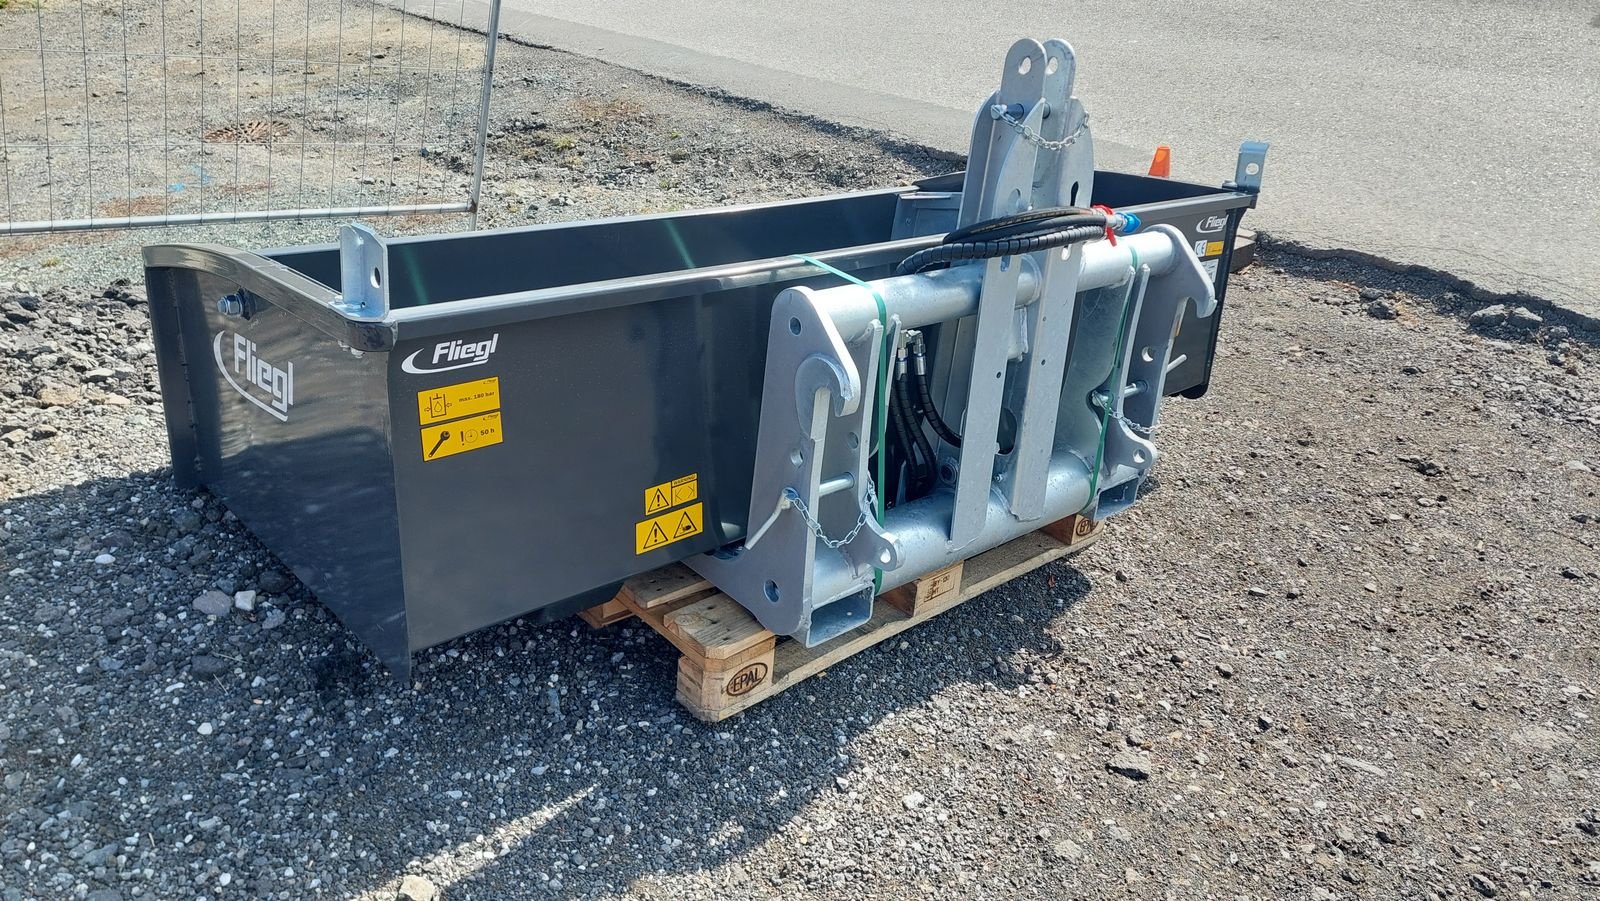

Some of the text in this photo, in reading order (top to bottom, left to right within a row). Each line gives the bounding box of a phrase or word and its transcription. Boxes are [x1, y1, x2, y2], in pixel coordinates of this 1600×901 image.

[1205, 214, 1229, 229] Fliegl
[432, 333, 499, 365] Fliegl
[234, 332, 294, 413] Fliegl
[473, 392, 485, 400] 180
[733, 667, 762, 693] EPAL
